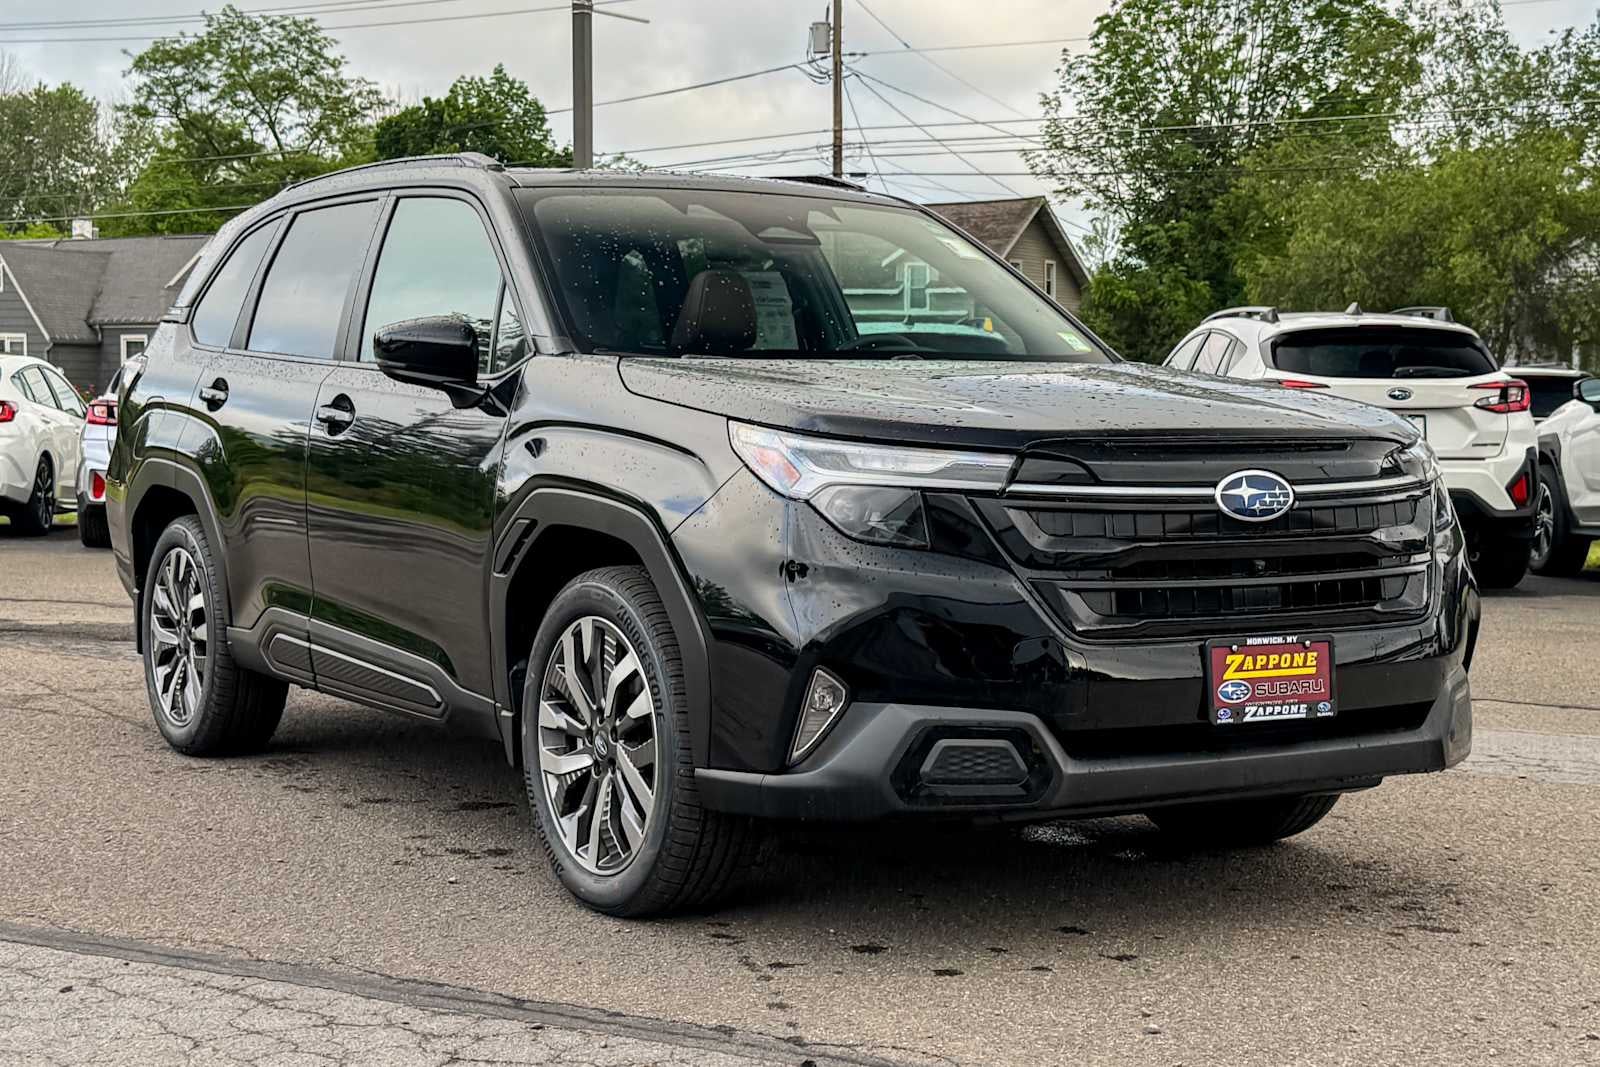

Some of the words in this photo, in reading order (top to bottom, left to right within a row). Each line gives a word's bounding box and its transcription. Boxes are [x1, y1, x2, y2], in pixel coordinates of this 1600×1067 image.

[1246, 636, 1285, 646] NORWICH,
[1286, 635, 1298, 644] NY
[1223, 651, 1318, 680] ZAPPONE
[1255, 679, 1325, 697] SUBARU
[1243, 704, 1308, 722] ZAPPONE
